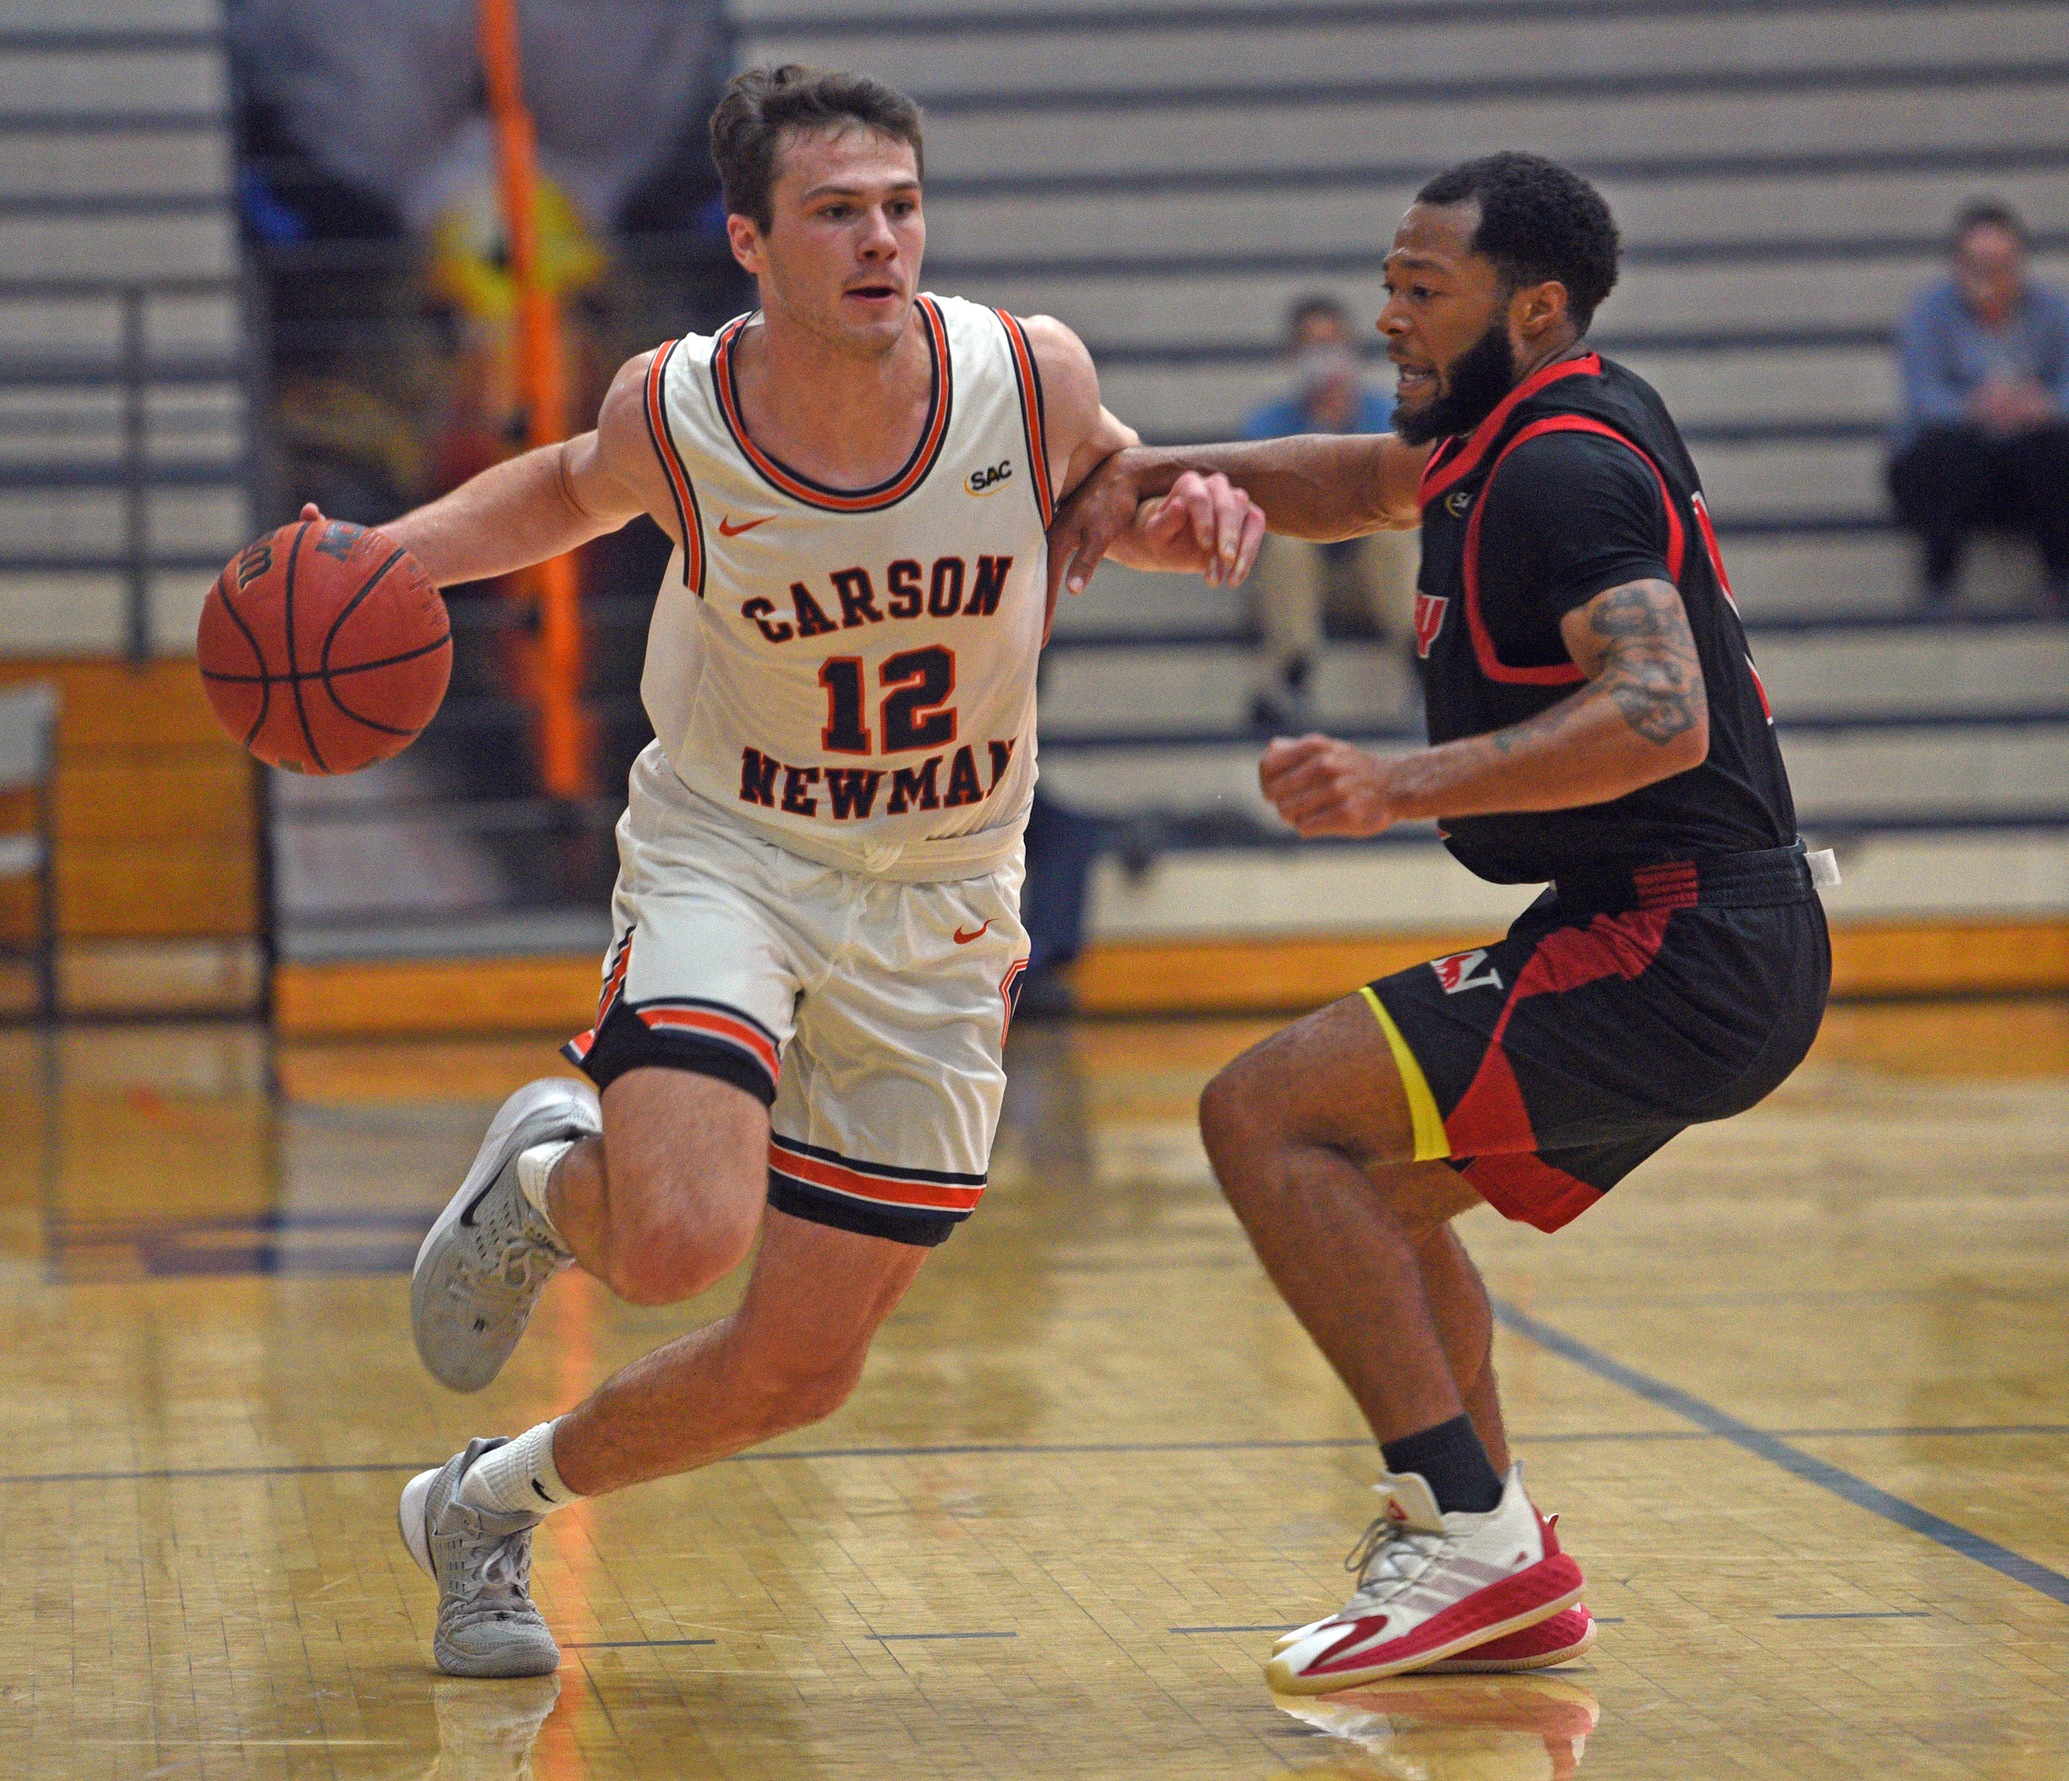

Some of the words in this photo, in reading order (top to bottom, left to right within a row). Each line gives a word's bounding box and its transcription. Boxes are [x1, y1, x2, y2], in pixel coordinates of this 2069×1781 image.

[970, 460, 1013, 491] SAC
[740, 554, 1014, 644] CARSON
[818, 643, 958, 756] 12
